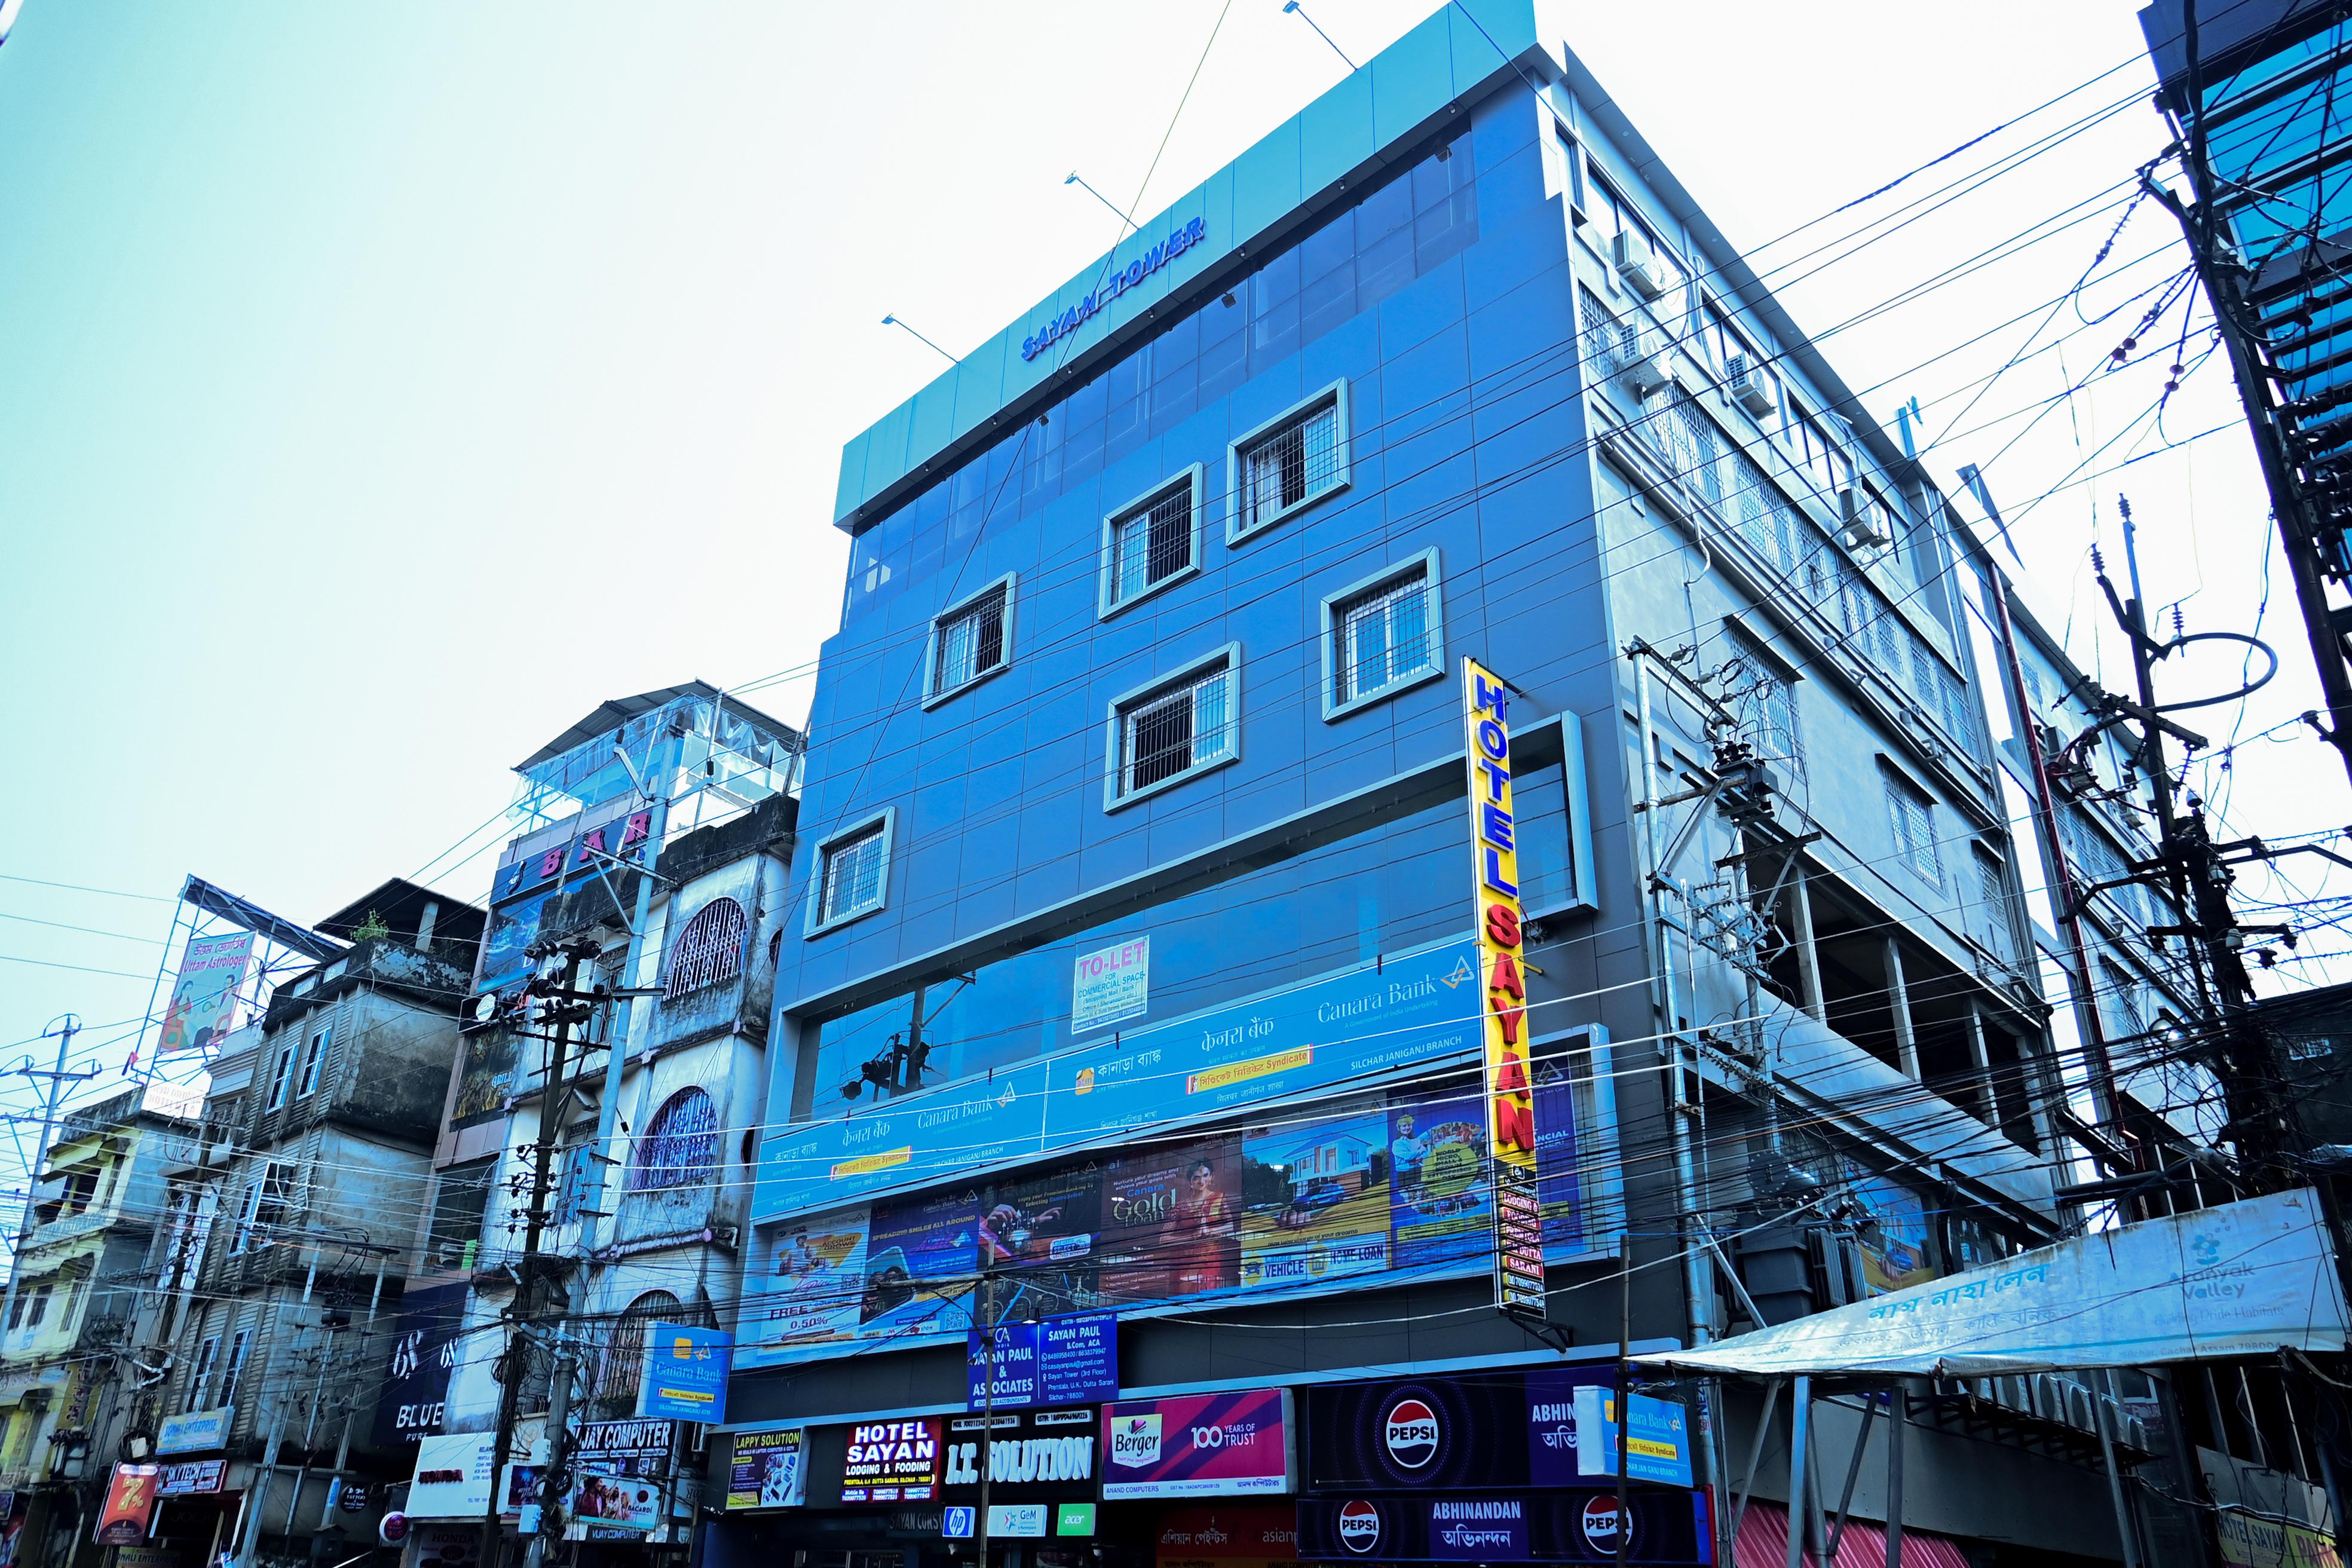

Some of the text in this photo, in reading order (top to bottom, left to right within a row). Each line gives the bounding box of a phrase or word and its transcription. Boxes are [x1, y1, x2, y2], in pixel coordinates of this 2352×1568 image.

[1021, 216, 1206, 361] SAYAN TOWER
[1472, 673, 1518, 898] HOTEL
[540, 812, 651, 879] BAR
[184, 955, 246, 972] Uttam Astrologer
[1079, 942, 1146, 980] TO-LET
[1078, 979, 1120, 998] COMMERCIAL
[1318, 975, 1437, 1022] Canara Bank
[1349, 1016, 1382, 1027] Government
[1390, 1007, 1403, 1016] India
[1404, 999, 1438, 1013] Undertaking
[1202, 1016, 1276, 1052] केनरा बैंक
[1486, 903, 1535, 1150] SAYAN
[1266, 1052, 1307, 1070] Syndicate
[1350, 1036, 1462, 1070] SILCHAR JANIGANJ BRANCH
[1267, 1081, 1284, 1091] शाखा
[918, 1107, 958, 1129] Canara
[963, 1095, 993, 1117] Bank
[981, 1146, 1003, 1156] BRANCH
[1113, 1178, 1134, 1186] Nurture
[1115, 1182, 1135, 1190] achieve
[1136, 1179, 1148, 1187] your
[1149, 1176, 1163, 1184] goals
[1033, 1193, 1043, 1202] your
[1128, 1184, 1164, 1198] Canara
[1025, 1199, 1048, 1207] Selecting
[1113, 1188, 1176, 1220] Gold
[1503, 1192, 1531, 1211] LODGING
[872, 1230, 908, 1241] SPREADING
[908, 1224, 932, 1233] SMILES
[946, 1215, 976, 1224] AROUND
[1321, 1231, 1334, 1239] your
[822, 1236, 856, 1247] ACCOUNT
[1053, 1244, 1076, 1254] SELECT
[1358, 1245, 1384, 1261] LOAN
[1520, 1245, 1541, 1260] DUTTA
[1264, 1260, 1304, 1278] VEHICLE
[1509, 1259, 1540, 1275] SARANI
[2170, 1261, 2256, 1283] Aranyak
[1869, 1264, 2050, 1319] নাগ নাহা লেন
[2180, 1283, 2245, 1300] Valley
[770, 1305, 808, 1320] FREE
[2200, 1308, 2231, 1323] Pride
[2234, 1304, 2285, 1319] Habitats
[790, 1316, 828, 1329] 0.50%
[1049, 1325, 1100, 1342] SAYAN PAUL
[1088, 1339, 1100, 1347] ACA
[2200, 1344, 2235, 1353] Assam
[1008, 1347, 1033, 1362] PAUL
[657, 1362, 722, 1382] Canara Bank
[999, 1365, 1007, 1379] &
[973, 1378, 1033, 1396] ASOCIATES
[396, 1402, 445, 1428] BLUE
[1649, 1413, 1668, 1430] Bank
[185, 1419, 218, 1434] ENTERPRISE
[855, 1422, 928, 1444] HOTEL
[1389, 1426, 1435, 1440] PEPSI
[605, 1422, 671, 1449] COMPUTER
[736, 1432, 800, 1448] LAPPY SOLUTION
[1191, 1423, 1255, 1448] 100 YEARS OF
[1224, 1433, 1255, 1447] TRUST
[847, 1440, 934, 1463] SAYAN
[1116, 1434, 1159, 1457] Berger
[167, 1464, 202, 1481] SKYTECH
[846, 1461, 931, 1475] LODGING & FOODING
[1659, 1466, 1678, 1477] BRANCH
[118, 1478, 144, 1511] 7%
[627, 1505, 653, 1514] BACARDÍ
[1020, 1509, 1036, 1520] GeM
[1433, 1501, 1521, 1520] ABHINANDAN
[952, 1508, 964, 1536] hp
[1065, 1515, 1085, 1524] acer
[1342, 1519, 1377, 1531] PEPSI
[432, 1533, 474, 1544] HONDA
[592, 1530, 640, 1539] VIJAY COMPUTER
[1161, 1529, 1191, 1545] এশিয়ান
[1442, 1524, 1511, 1548] অভিনন্দন
[2221, 1515, 2253, 1546] HOTEL
